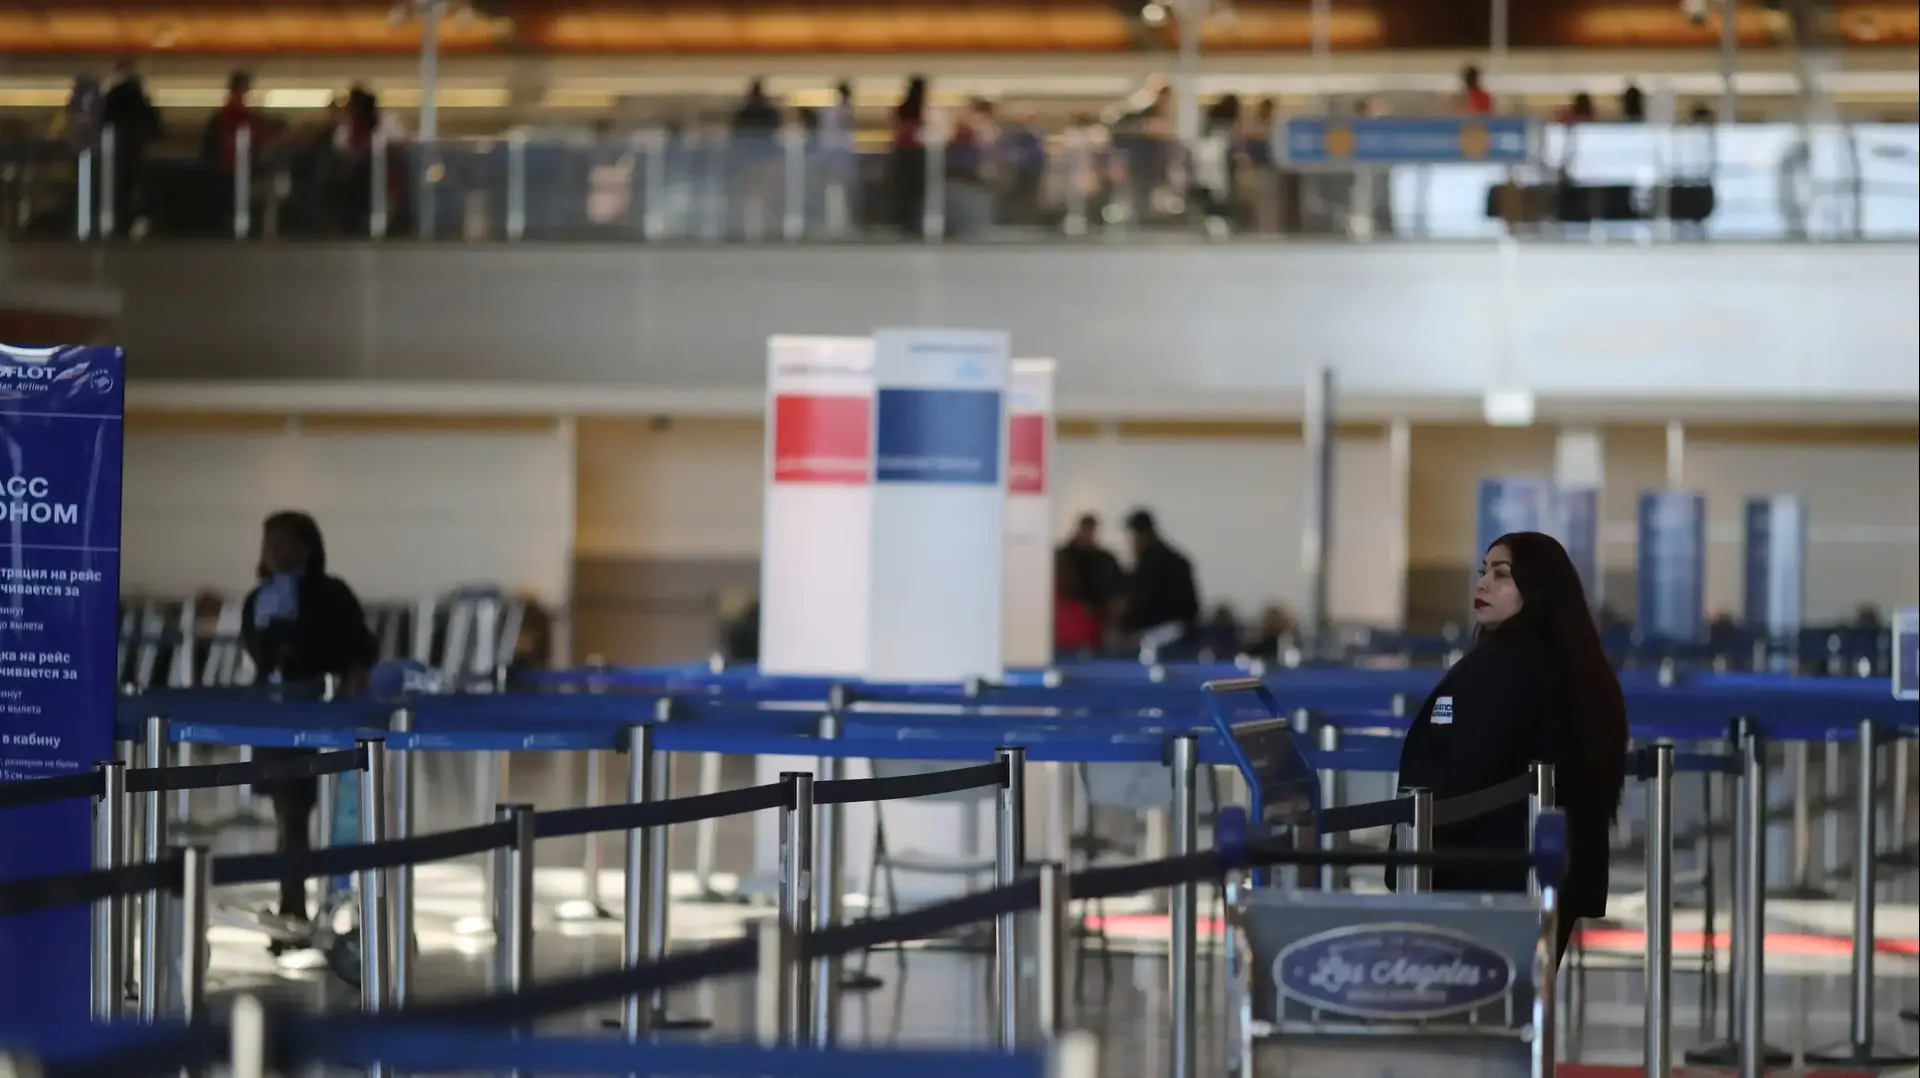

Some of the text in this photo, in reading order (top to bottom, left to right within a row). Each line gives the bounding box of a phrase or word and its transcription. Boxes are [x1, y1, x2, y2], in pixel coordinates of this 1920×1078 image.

[16, 382, 49, 392] Airlines
[51, 569, 67, 580] на
[70, 568, 102, 583] рейс
[0, 583, 80, 597] чивается за
[9, 621, 44, 632] вылета
[0, 650, 71, 665] ка на рейс
[62, 669, 78, 681] за
[7, 704, 42, 715] вылета
[2, 732, 61, 750] в кабину
[1370, 956, 1481, 995] Angeles
